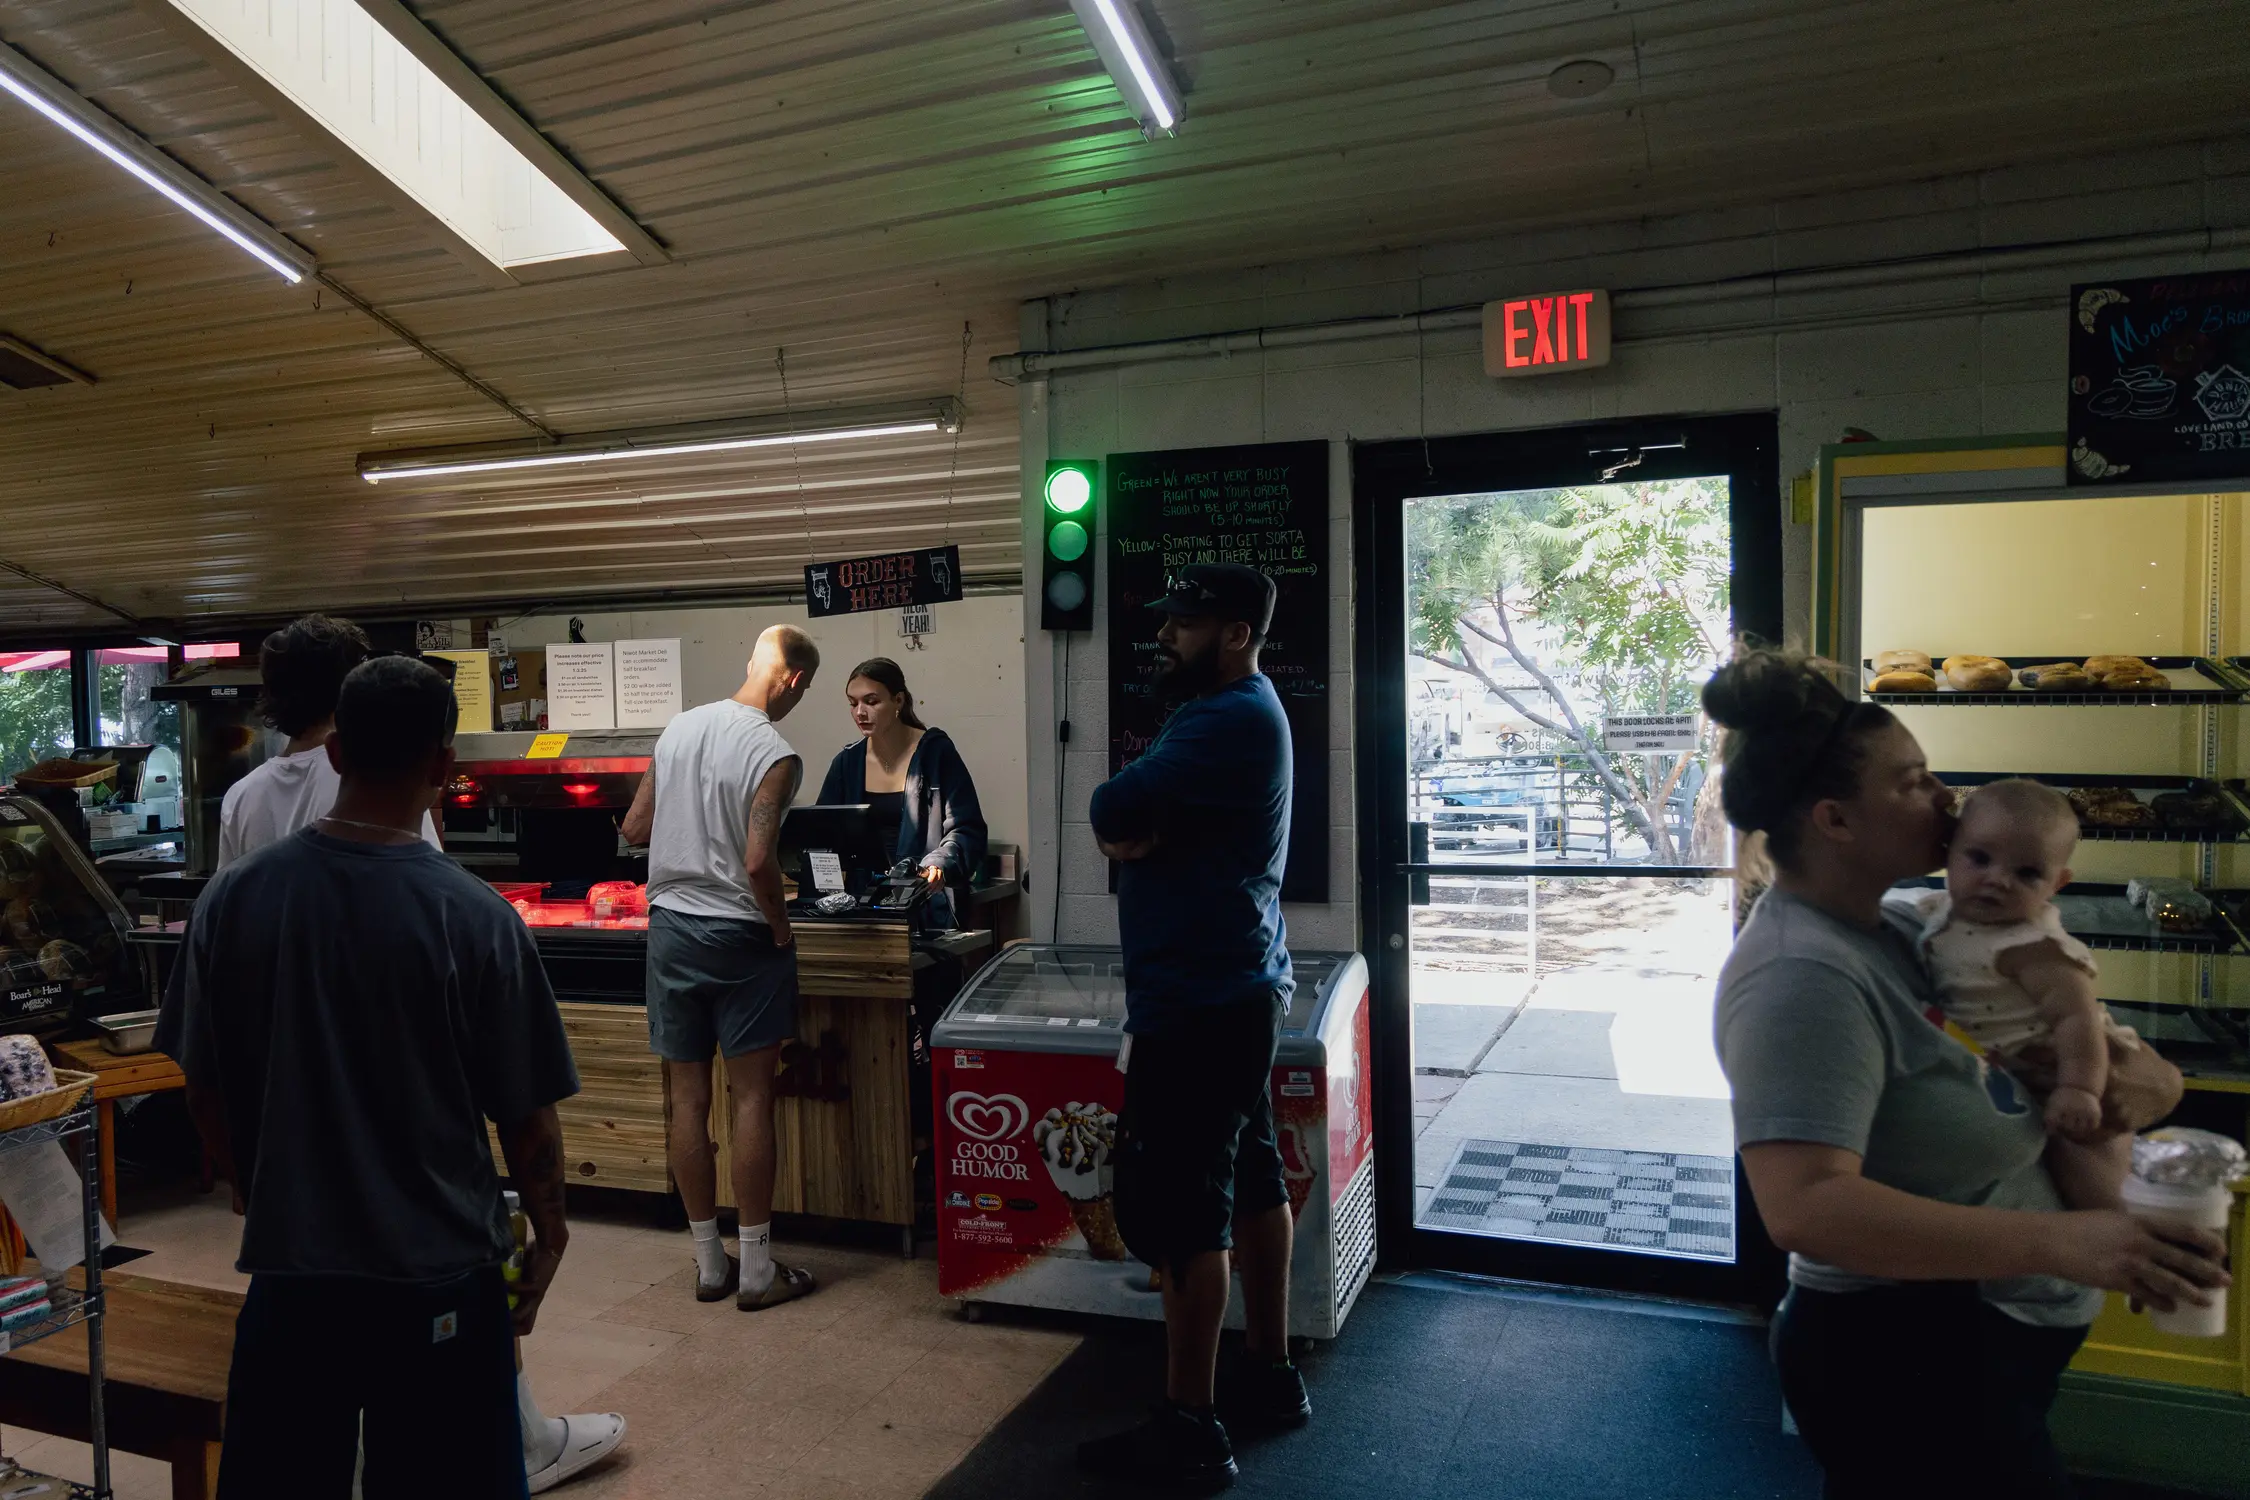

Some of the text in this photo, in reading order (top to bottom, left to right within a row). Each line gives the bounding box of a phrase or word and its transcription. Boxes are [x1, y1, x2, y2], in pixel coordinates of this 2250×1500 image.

[1503, 292, 1594, 368] EXIT
[1223, 468, 1251, 481] VERY
[1256, 465, 1291, 481] BUSY
[1162, 484, 1290, 504] RIGHT NOW YOUR ORDER
[1162, 499, 1293, 517] SHOULD BE UP SHORTLY
[1162, 533, 1213, 551] STARTING
[1219, 535, 1233, 549] TO
[1236, 533, 1259, 548] GET
[1265, 530, 1305, 545] SORTA
[1163, 545, 1307, 567] BUSY AND THERE WILL BE
[839, 555, 918, 588] ORDER
[849, 581, 913, 611] HERE
[901, 615, 930, 633] YEAH!
[1259, 665, 1308, 674] ECIATED.
[211, 688, 238, 696] GILES
[1608, 718, 1623, 727] THIS
[42, 984, 61, 995] Head
[956, 1141, 1019, 1162] GOOD
[951, 1159, 1030, 1180] HUMOR
[953, 1233, 1013, 1244] 1-877-592-5600
